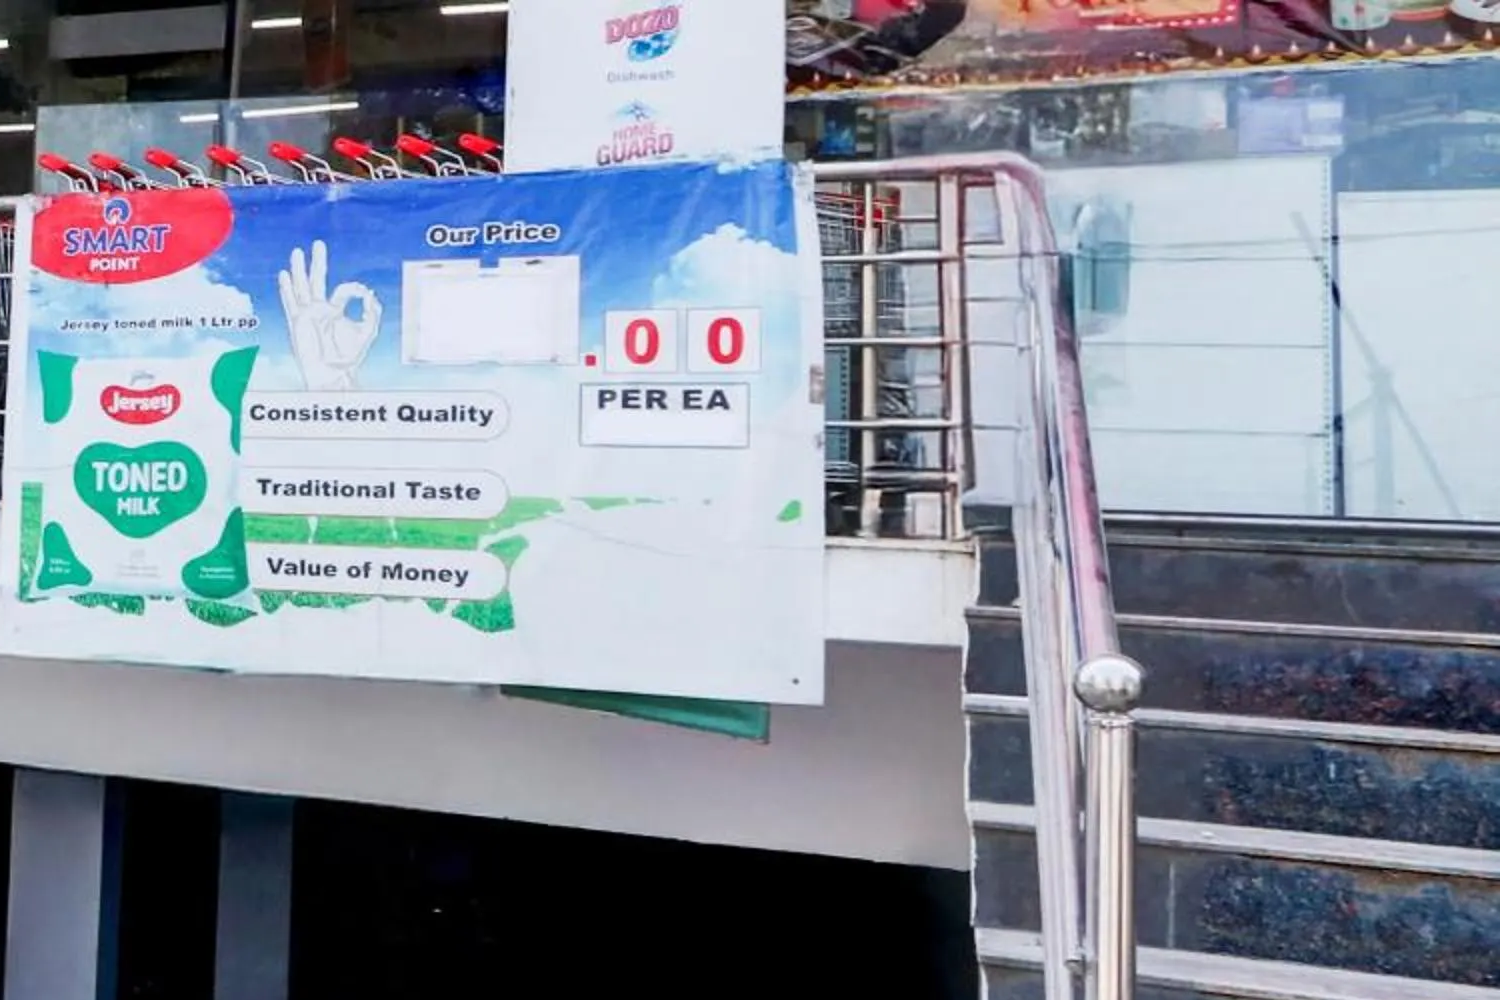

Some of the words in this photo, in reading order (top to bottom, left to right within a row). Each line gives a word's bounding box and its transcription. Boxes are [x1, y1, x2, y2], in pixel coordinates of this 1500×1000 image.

[607, 69, 675, 83] Dishwash
[613, 122, 656, 140] HOME
[596, 133, 674, 166] GUARD
[65, 225, 170, 254] SMART
[428, 227, 475, 244] Our
[486, 224, 557, 242] Price
[90, 256, 140, 272] POINT
[61, 318, 109, 332] Jersey
[114, 317, 156, 329] toned
[161, 317, 193, 327] milk
[199, 317, 206, 327] 1
[211, 316, 232, 327] Ltr
[238, 318, 258, 328] pp
[108, 391, 173, 414] Jersey
[598, 389, 669, 410] PER
[682, 389, 731, 410] EA
[250, 404, 387, 422] Consistent
[396, 404, 494, 427] Quality
[91, 460, 188, 493] TONED
[256, 478, 395, 499] Traditional
[405, 481, 482, 501] Taste
[117, 497, 161, 516] MILK
[267, 557, 337, 577] Value
[346, 561, 373, 579] of
[381, 562, 469, 588] Money
